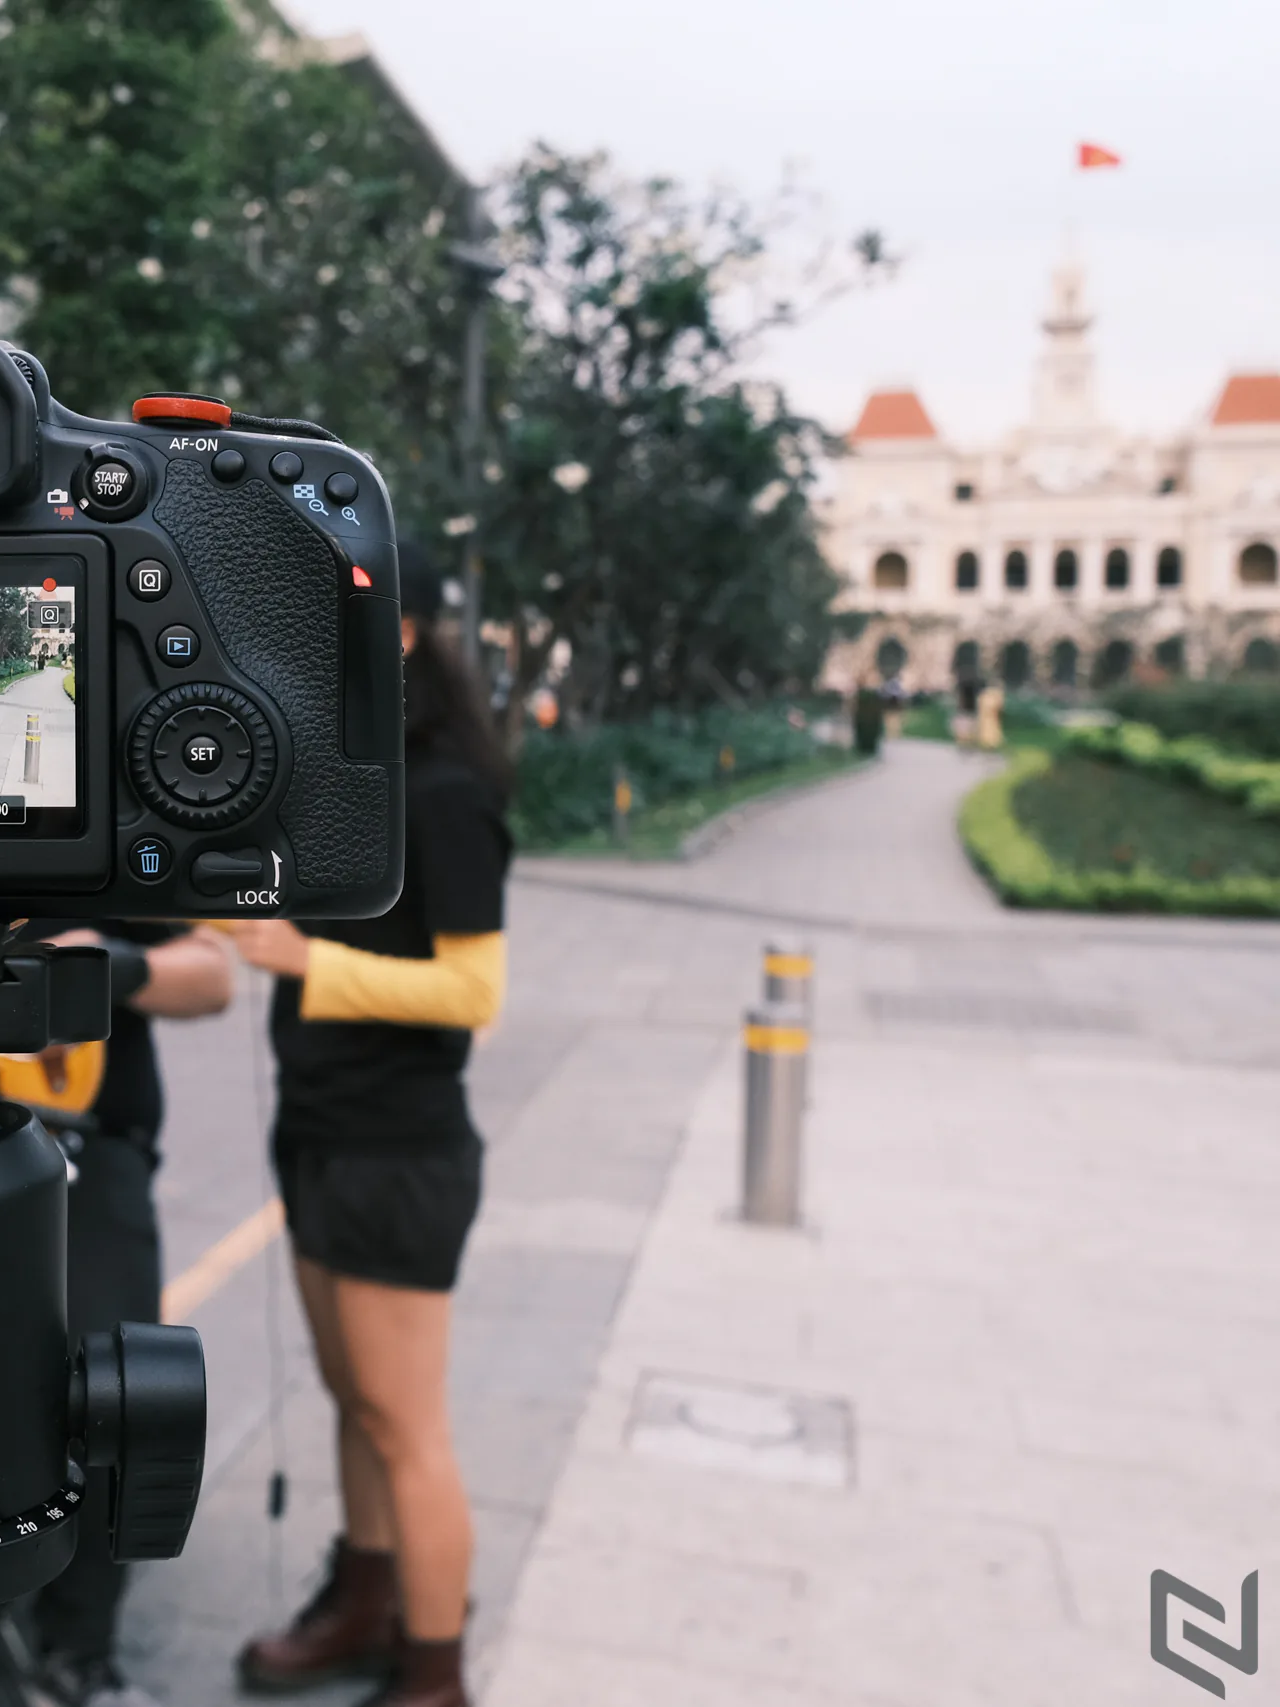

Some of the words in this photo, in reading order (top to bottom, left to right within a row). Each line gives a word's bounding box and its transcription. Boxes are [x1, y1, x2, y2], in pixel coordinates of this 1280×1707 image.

[169, 437, 218, 451] AF-ON
[94, 471, 128, 483] START/
[97, 483, 123, 496] STOP
[190, 747, 215, 761] SET
[236, 891, 279, 905] LOCK
[16, 1521, 38, 1535] 210
[46, 1507, 64, 1521] 195
